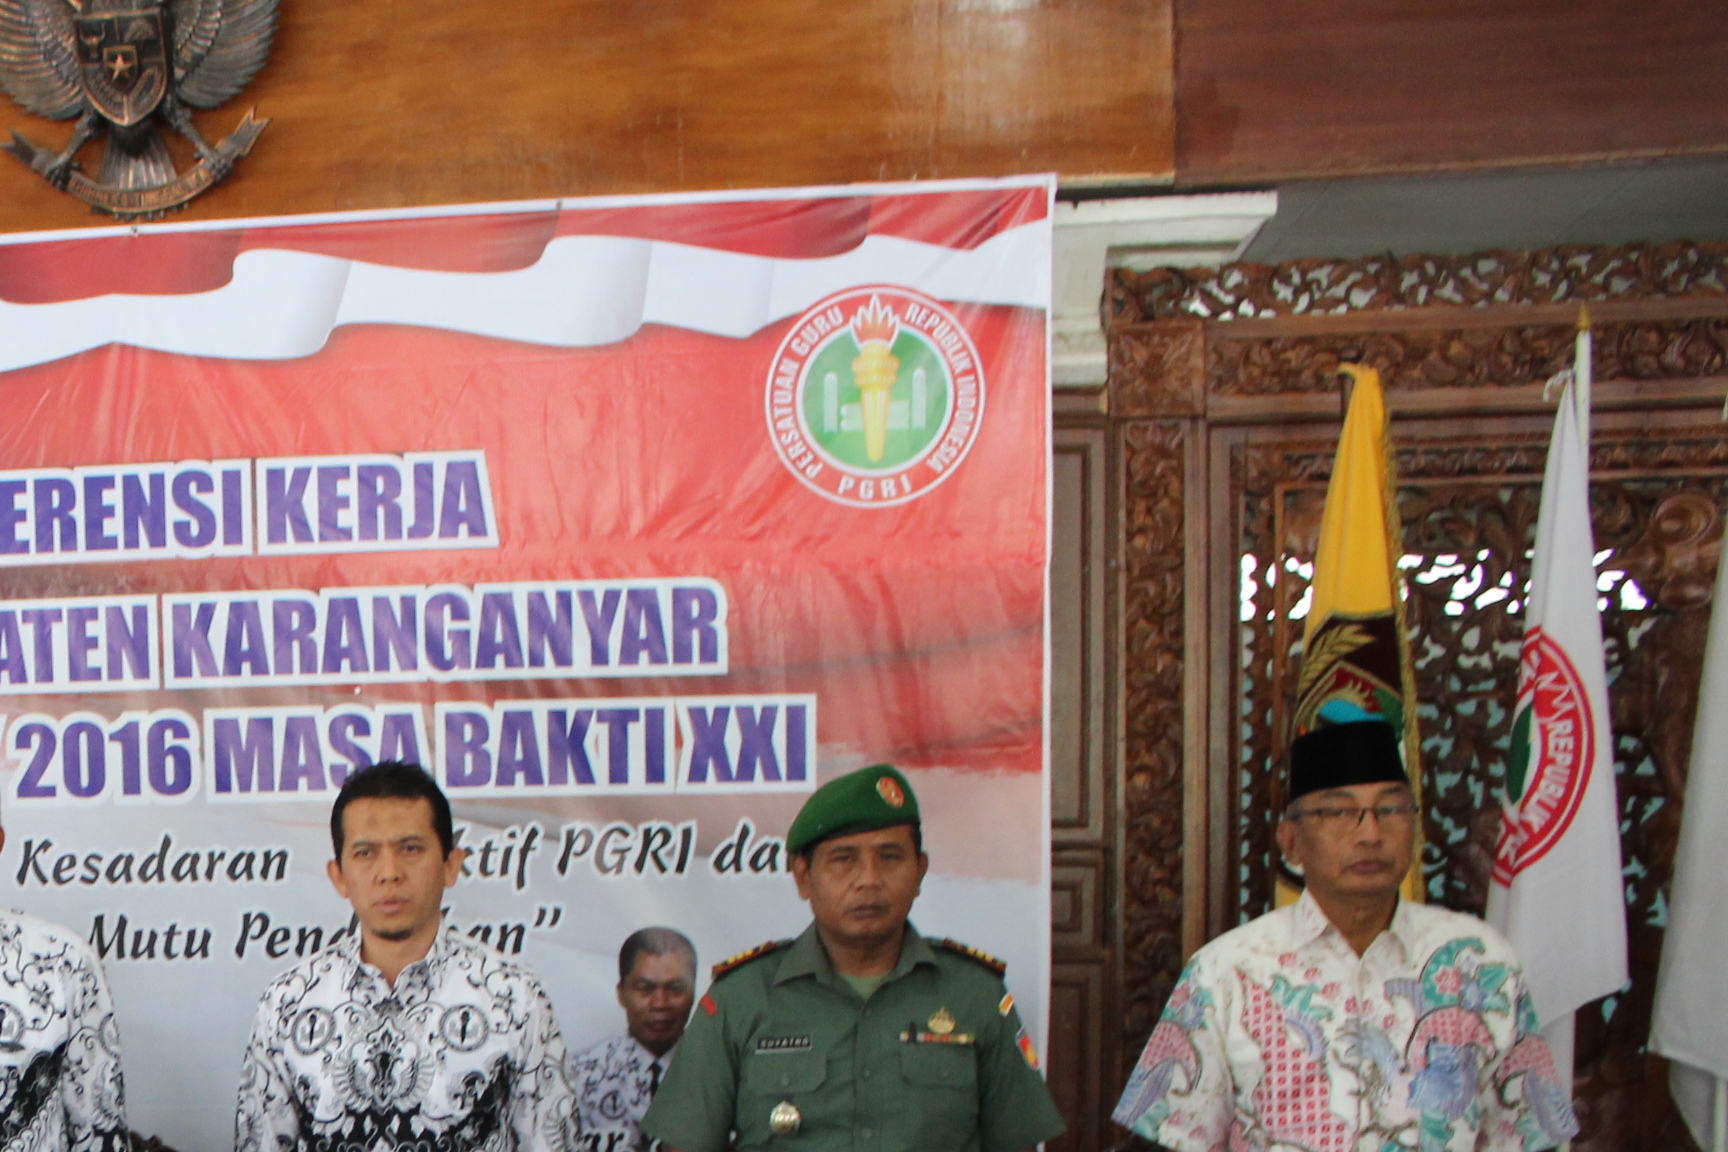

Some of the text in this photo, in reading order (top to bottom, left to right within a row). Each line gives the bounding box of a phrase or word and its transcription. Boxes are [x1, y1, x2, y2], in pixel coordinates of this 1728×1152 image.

[773, 302, 977, 480] PERSATUAN GURU REPUBLIK INDONESIA
[267, 460, 488, 544] KERJA
[836, 473, 913, 500] PGRI
[173, 587, 719, 678] KARANGANYAR
[16, 721, 192, 798] 2016
[214, 713, 421, 793] MASA
[446, 708, 665, 788] BAKTI
[689, 705, 807, 783] XXI
[16, 834, 289, 886] Kesadaran
[558, 826, 692, 876] PGRI
[88, 914, 212, 960] Mutu
